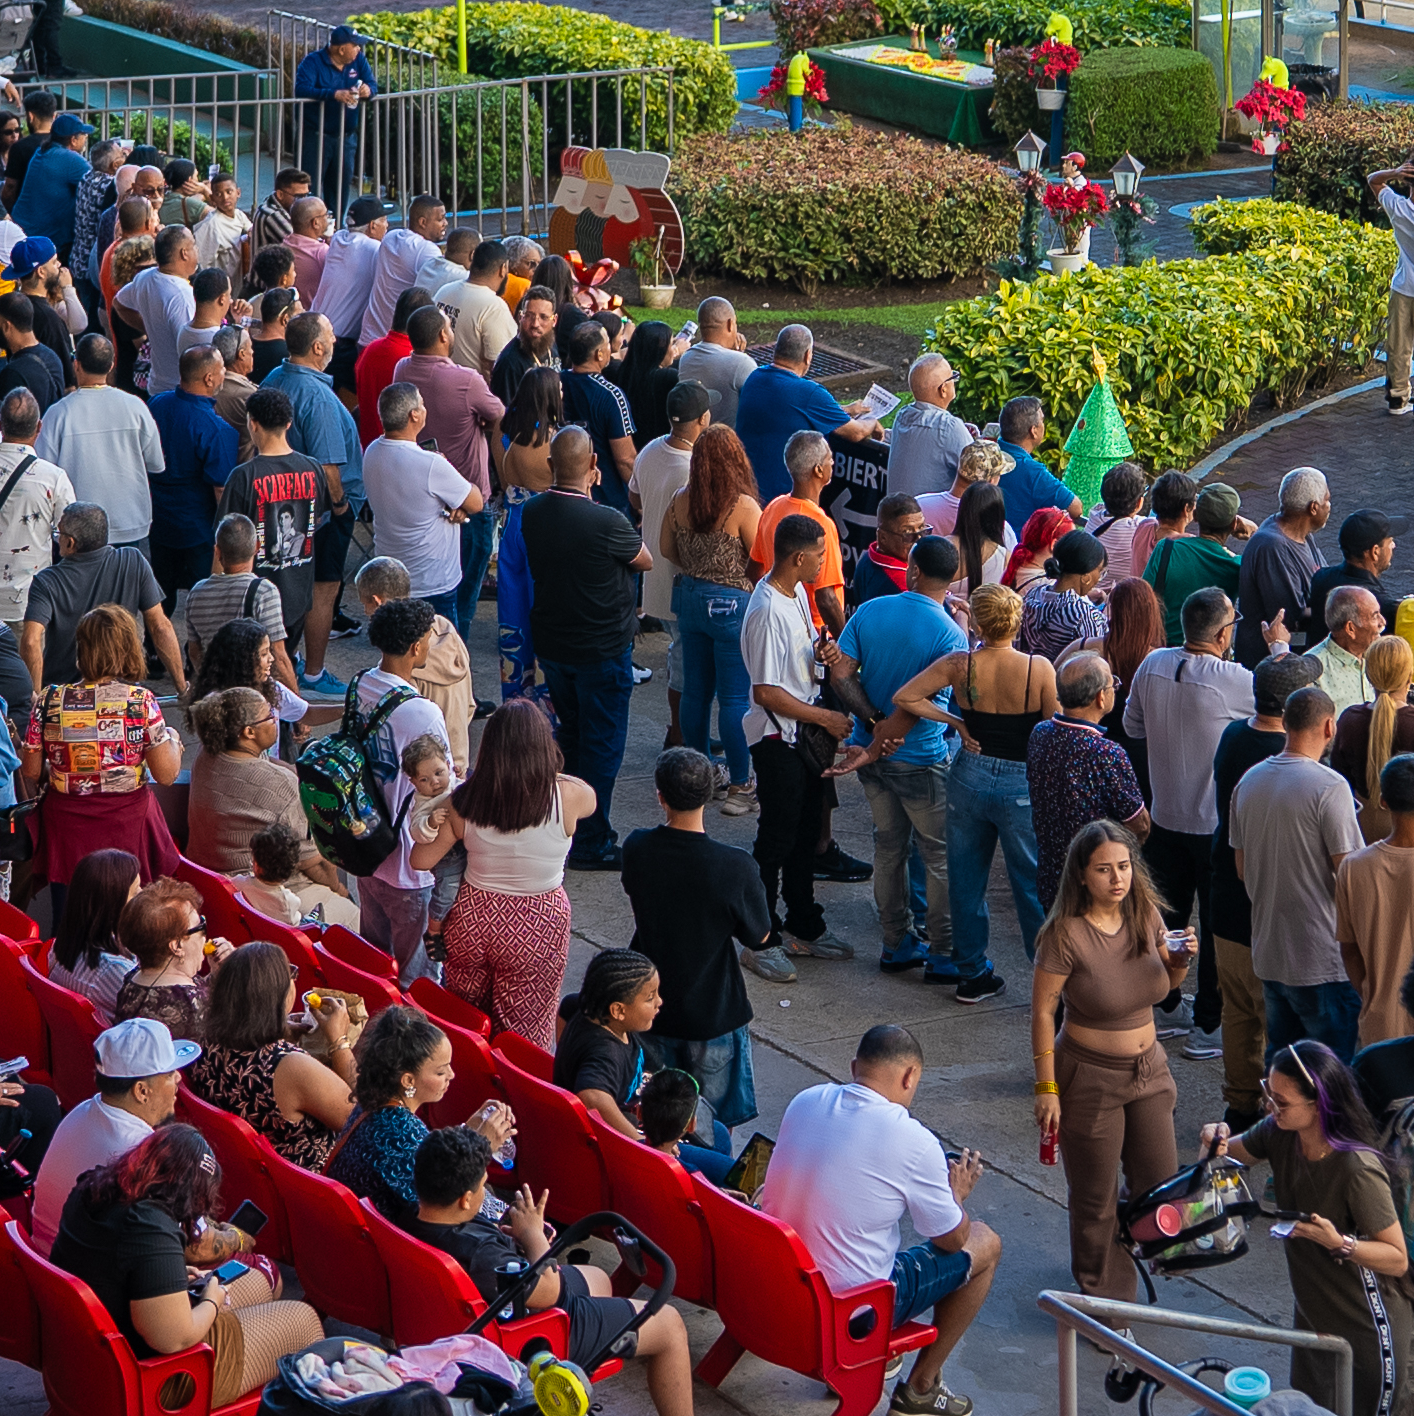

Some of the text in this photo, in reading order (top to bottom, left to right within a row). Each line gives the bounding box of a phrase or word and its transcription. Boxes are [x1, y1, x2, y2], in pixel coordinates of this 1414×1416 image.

[834, 451, 888, 492] BIERT
[253, 471, 317, 505] SCARFACE
[1370, 1291, 1384, 1318] DKNY
[1379, 1324, 1390, 1350] DKNY
[1385, 1357, 1393, 1383] DKNY
